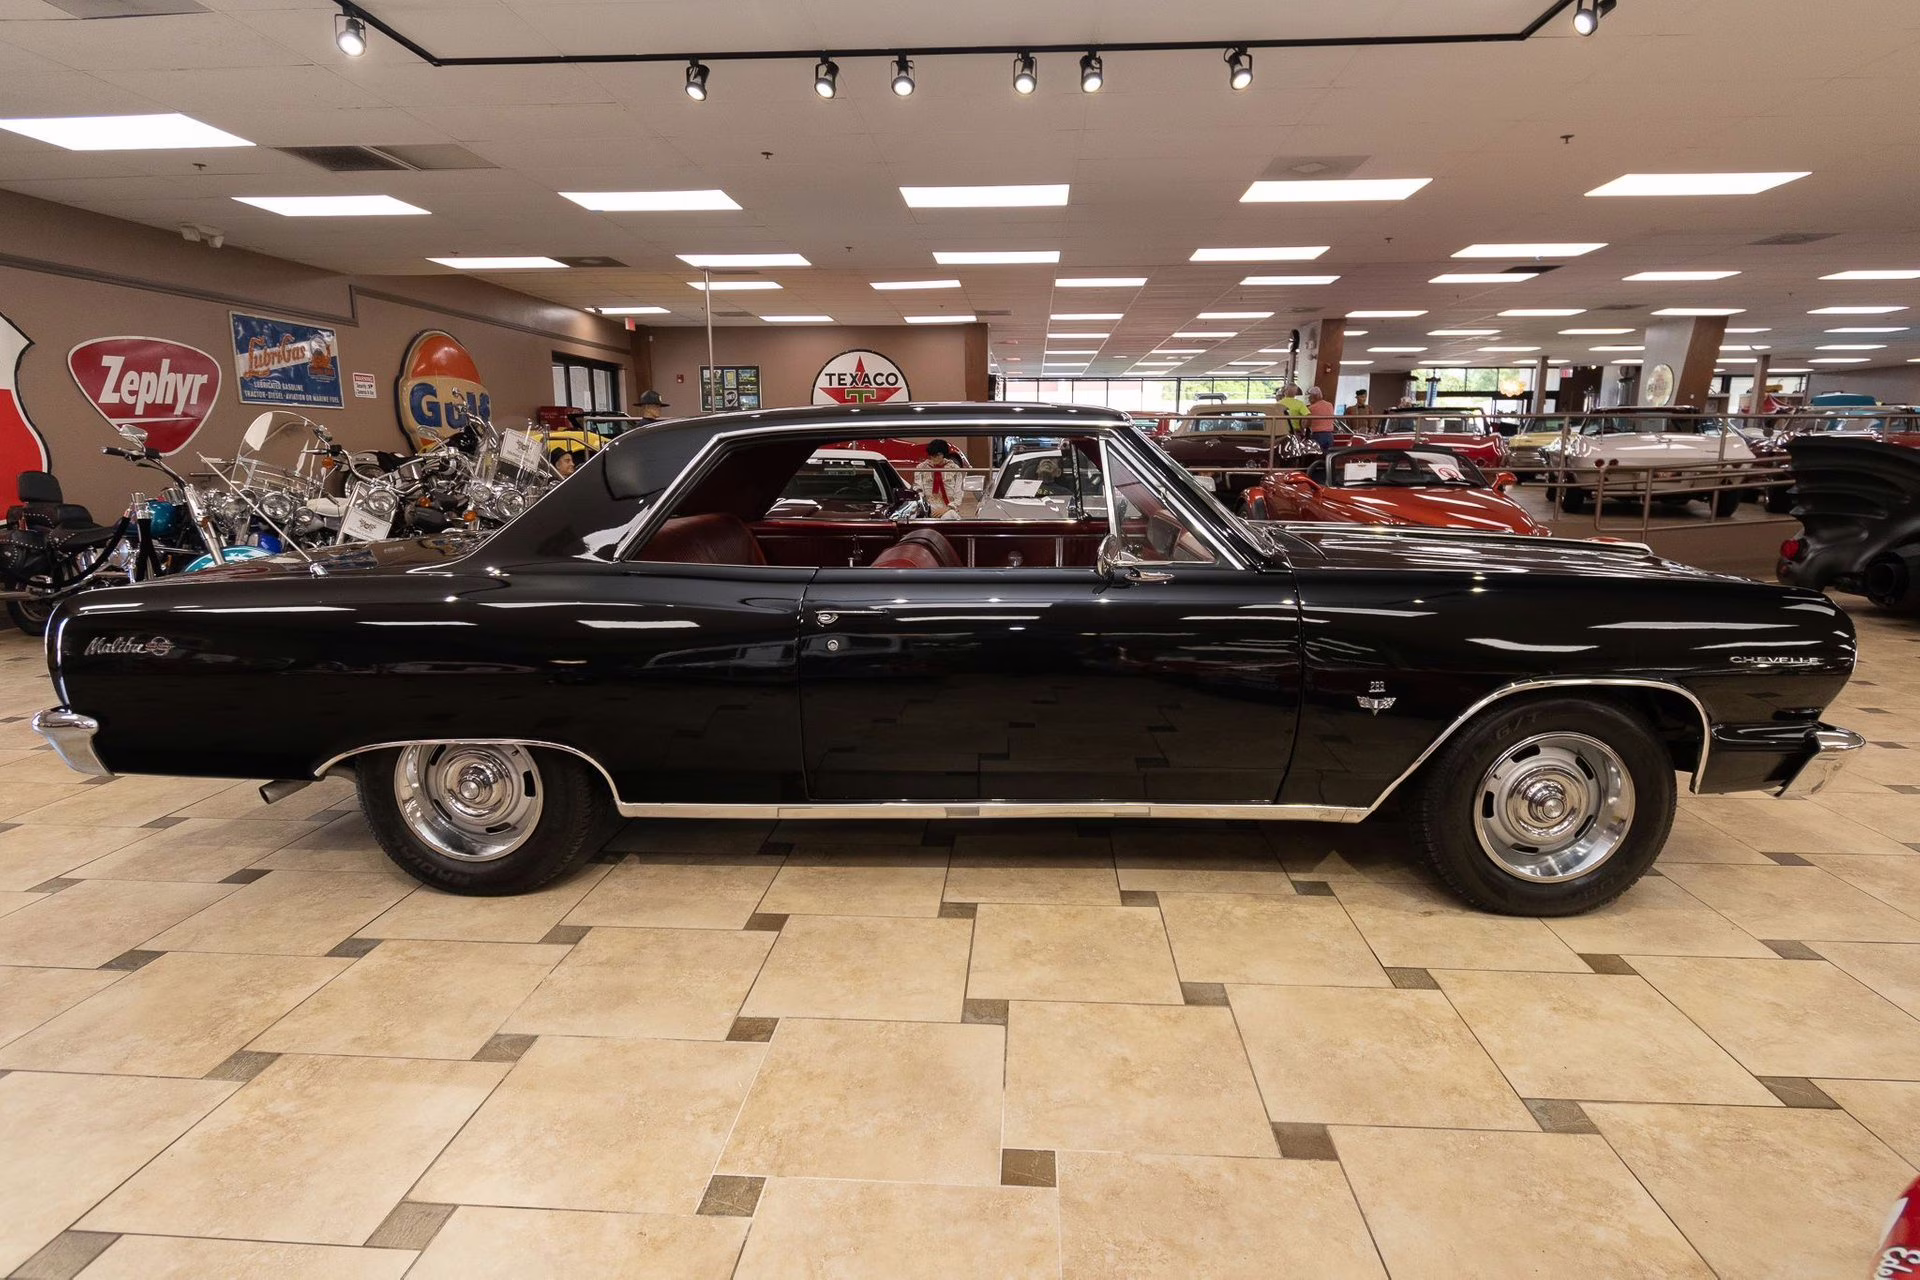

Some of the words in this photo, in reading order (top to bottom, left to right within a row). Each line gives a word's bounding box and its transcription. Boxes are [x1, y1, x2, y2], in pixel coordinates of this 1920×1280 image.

[243, 333, 306, 379] LubriGas
[98, 355, 208, 415] Zephyr
[825, 372, 899, 387] TEXACO
[409, 382, 491, 429] Gulf
[84, 636, 147, 656] Malibu
[1729, 656, 1823, 665] CHEVELLE
